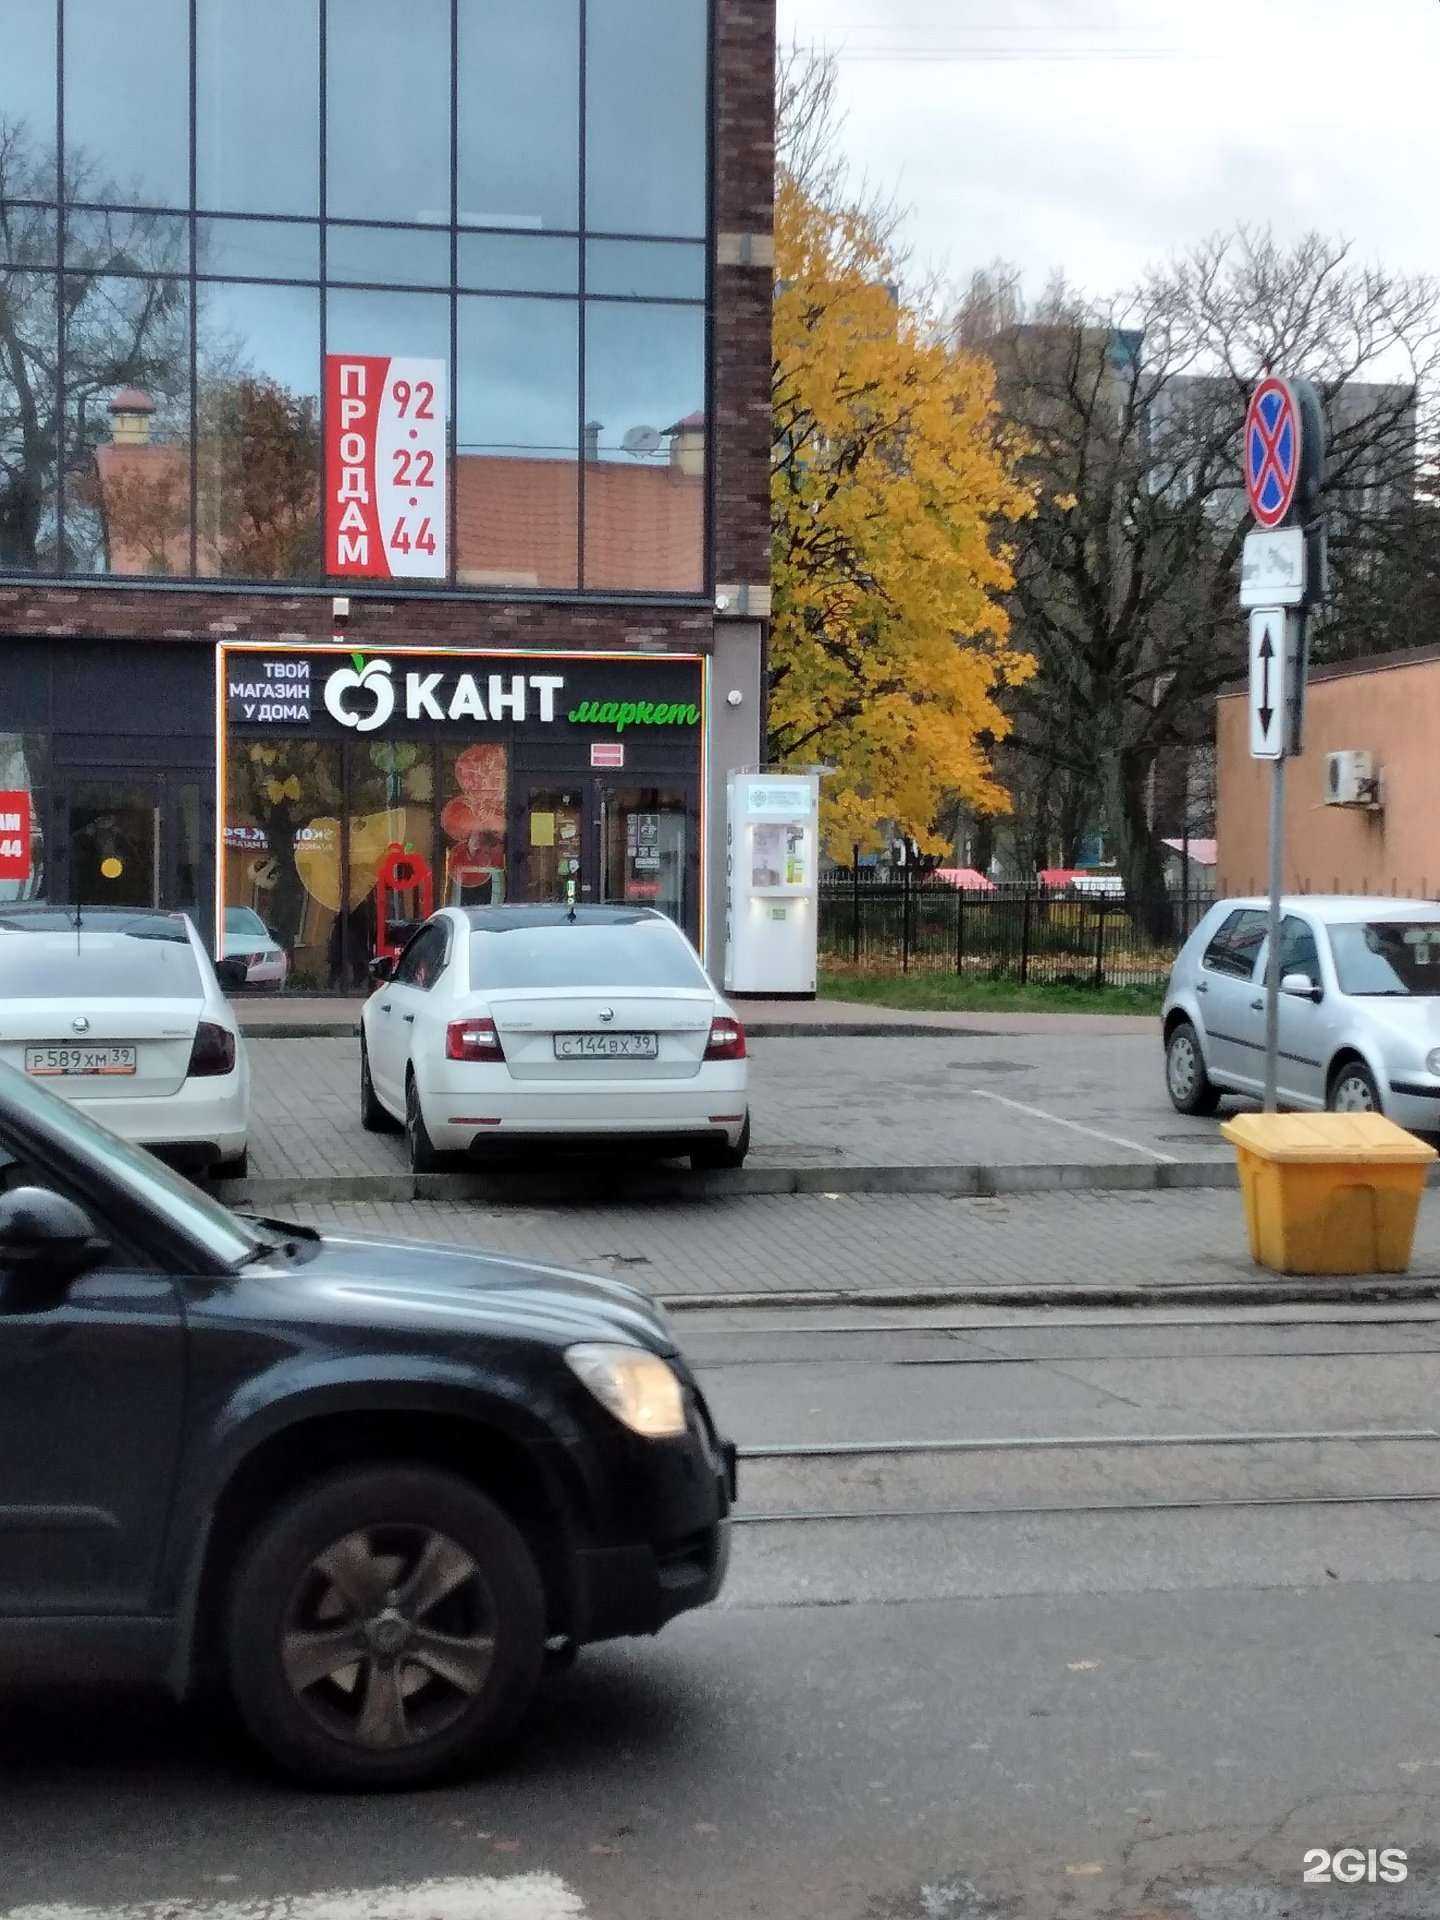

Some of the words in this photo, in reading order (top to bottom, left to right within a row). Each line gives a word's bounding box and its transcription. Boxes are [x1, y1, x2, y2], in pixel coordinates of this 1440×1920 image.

[392, 380, 434, 419] 92
[337, 364, 369, 566] ПРОДАМ
[392, 449, 434, 487] 22
[390, 516, 436, 556] 44
[263, 661, 310, 678] ТВОЙ
[229, 683, 310, 698] МАГАЗИН
[406, 673, 564, 721] КАНТ
[242, 704, 256, 718] У
[258, 704, 311, 722] ДОМА
[568, 701, 700, 733] маркет
